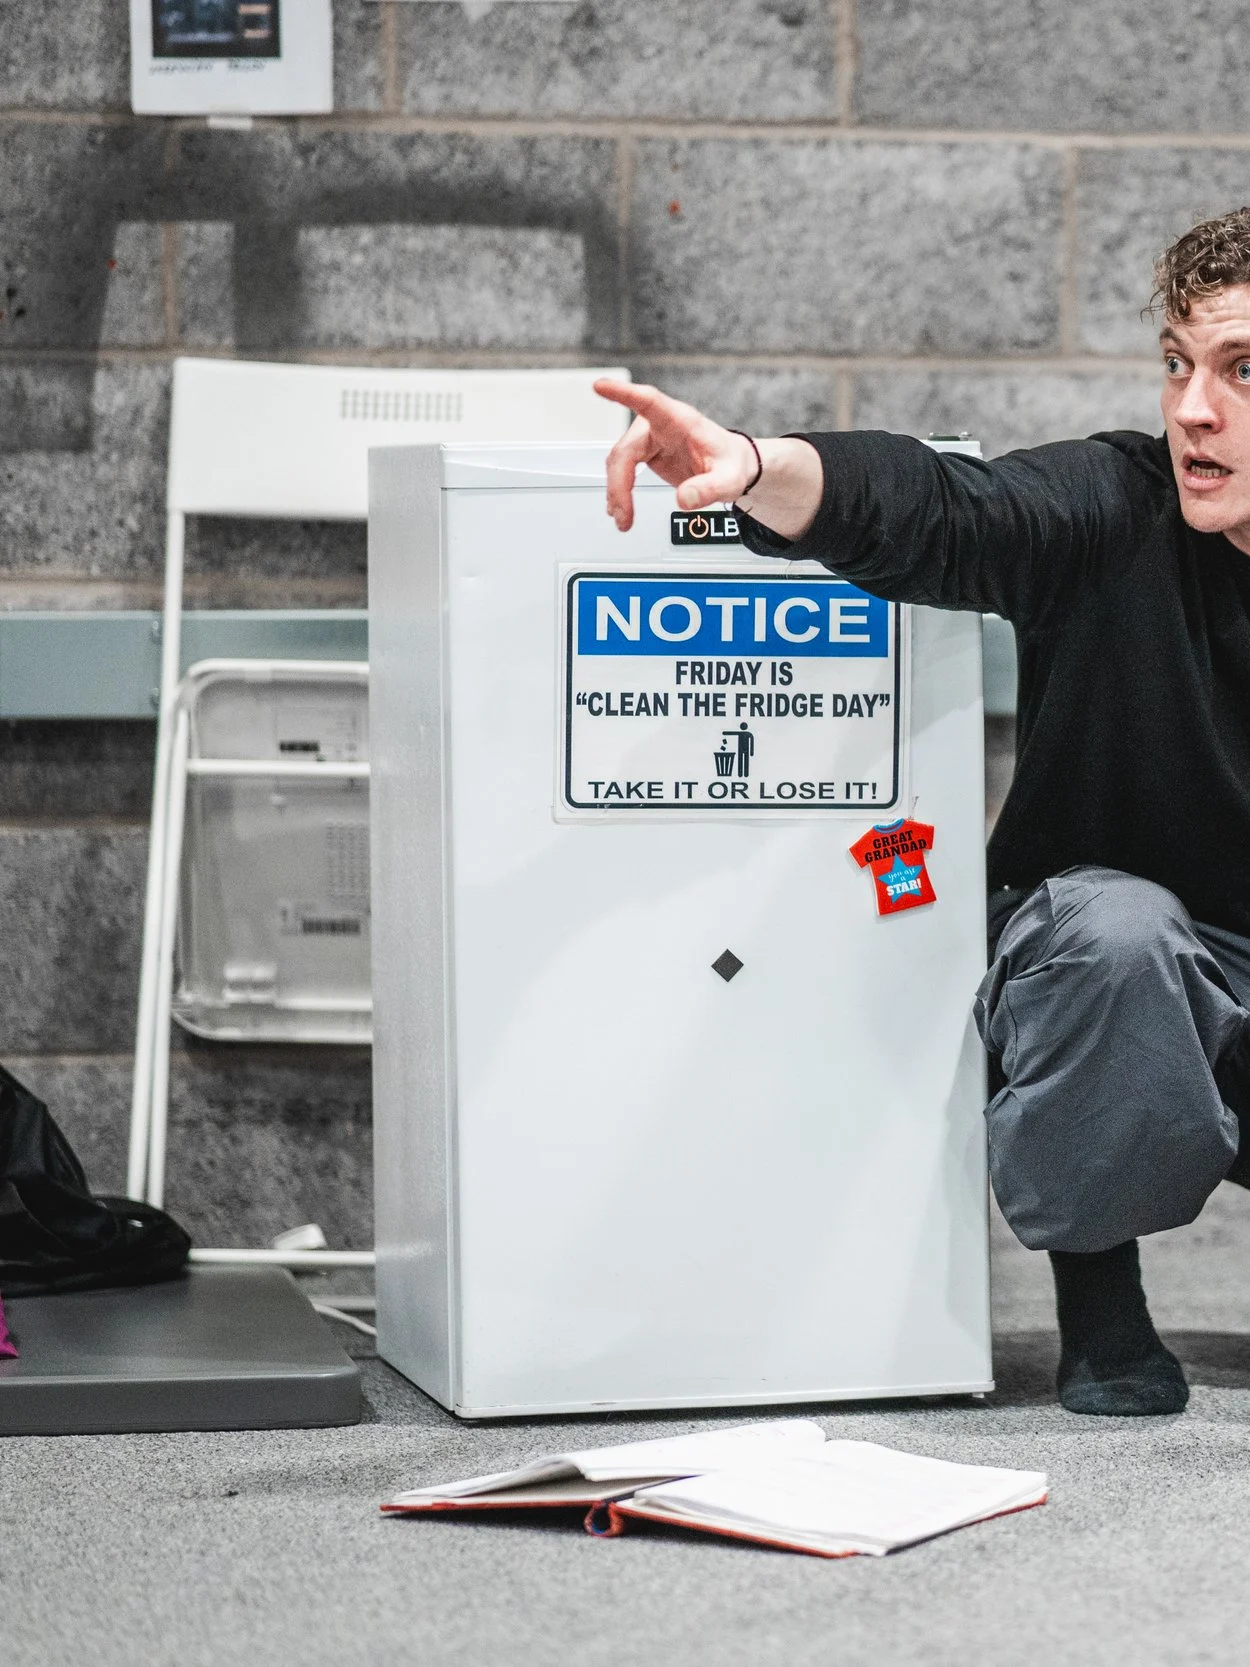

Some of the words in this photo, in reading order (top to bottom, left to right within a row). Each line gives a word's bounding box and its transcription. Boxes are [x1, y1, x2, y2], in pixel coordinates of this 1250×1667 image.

[674, 515, 740, 538] TOLB
[596, 596, 870, 643] NOTICE
[675, 661, 762, 686] FRIDAY
[771, 661, 793, 686] IS
[576, 692, 669, 717] “CLEAN
[678, 693, 727, 717] THE
[735, 693, 824, 718] FRIDGE
[832, 693, 891, 718] DAY”
[588, 781, 664, 799] TAKE
[674, 781, 699, 799] IT
[707, 781, 750, 800] OR
[759, 782, 835, 800] LOSE
[845, 782, 877, 800] IT!
[864, 839, 927, 863] GRANDAD
[873, 830, 913, 850] GREAT
[886, 878, 922, 897] STAR!
[888, 871, 903, 882] you
